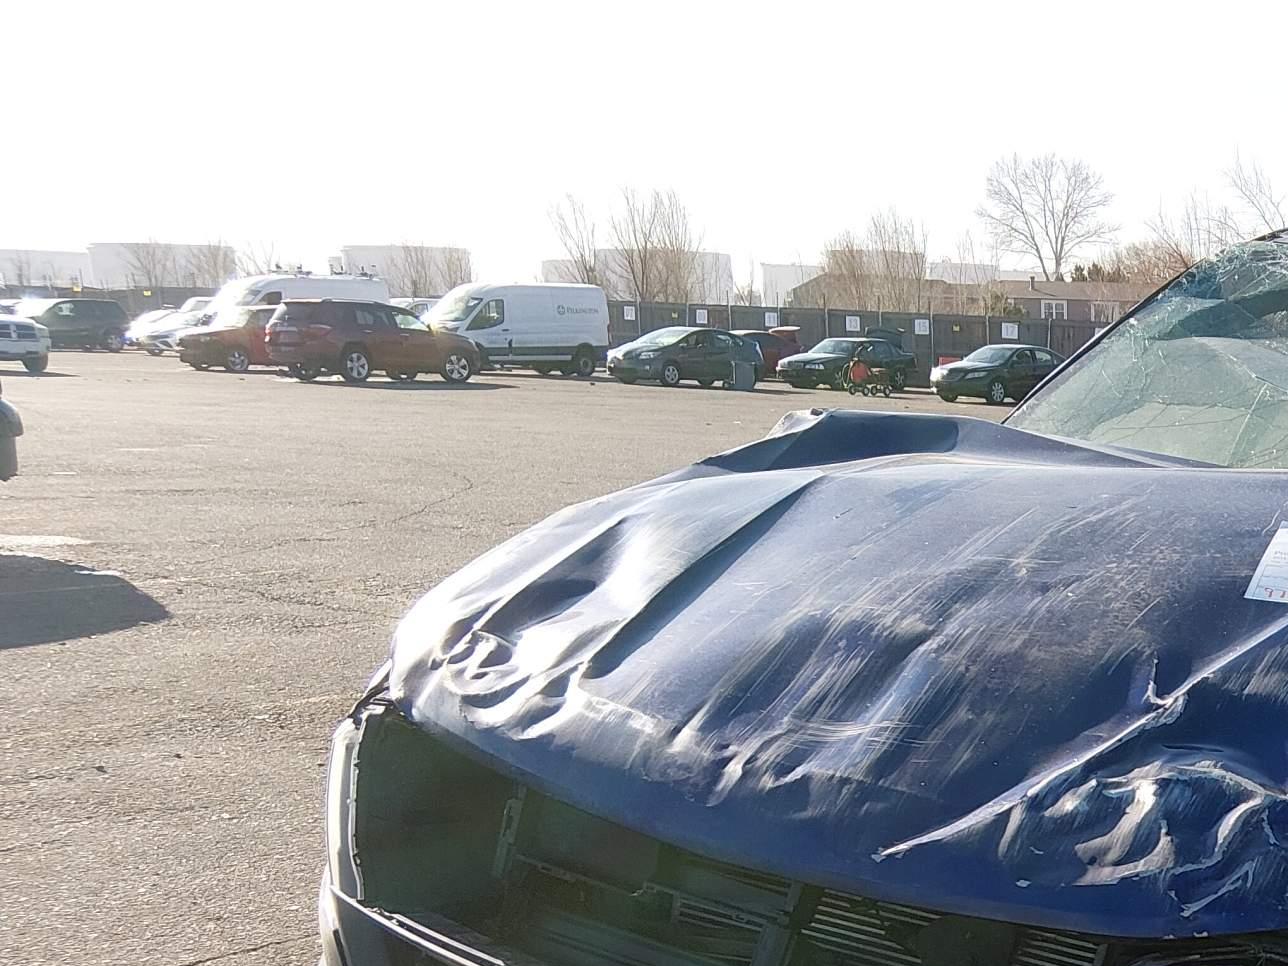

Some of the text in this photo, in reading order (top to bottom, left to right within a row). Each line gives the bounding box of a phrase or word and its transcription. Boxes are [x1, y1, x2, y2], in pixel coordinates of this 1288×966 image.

[849, 318, 858, 329] 13
[918, 320, 927, 332] 15
[1004, 324, 1014, 337] 17
